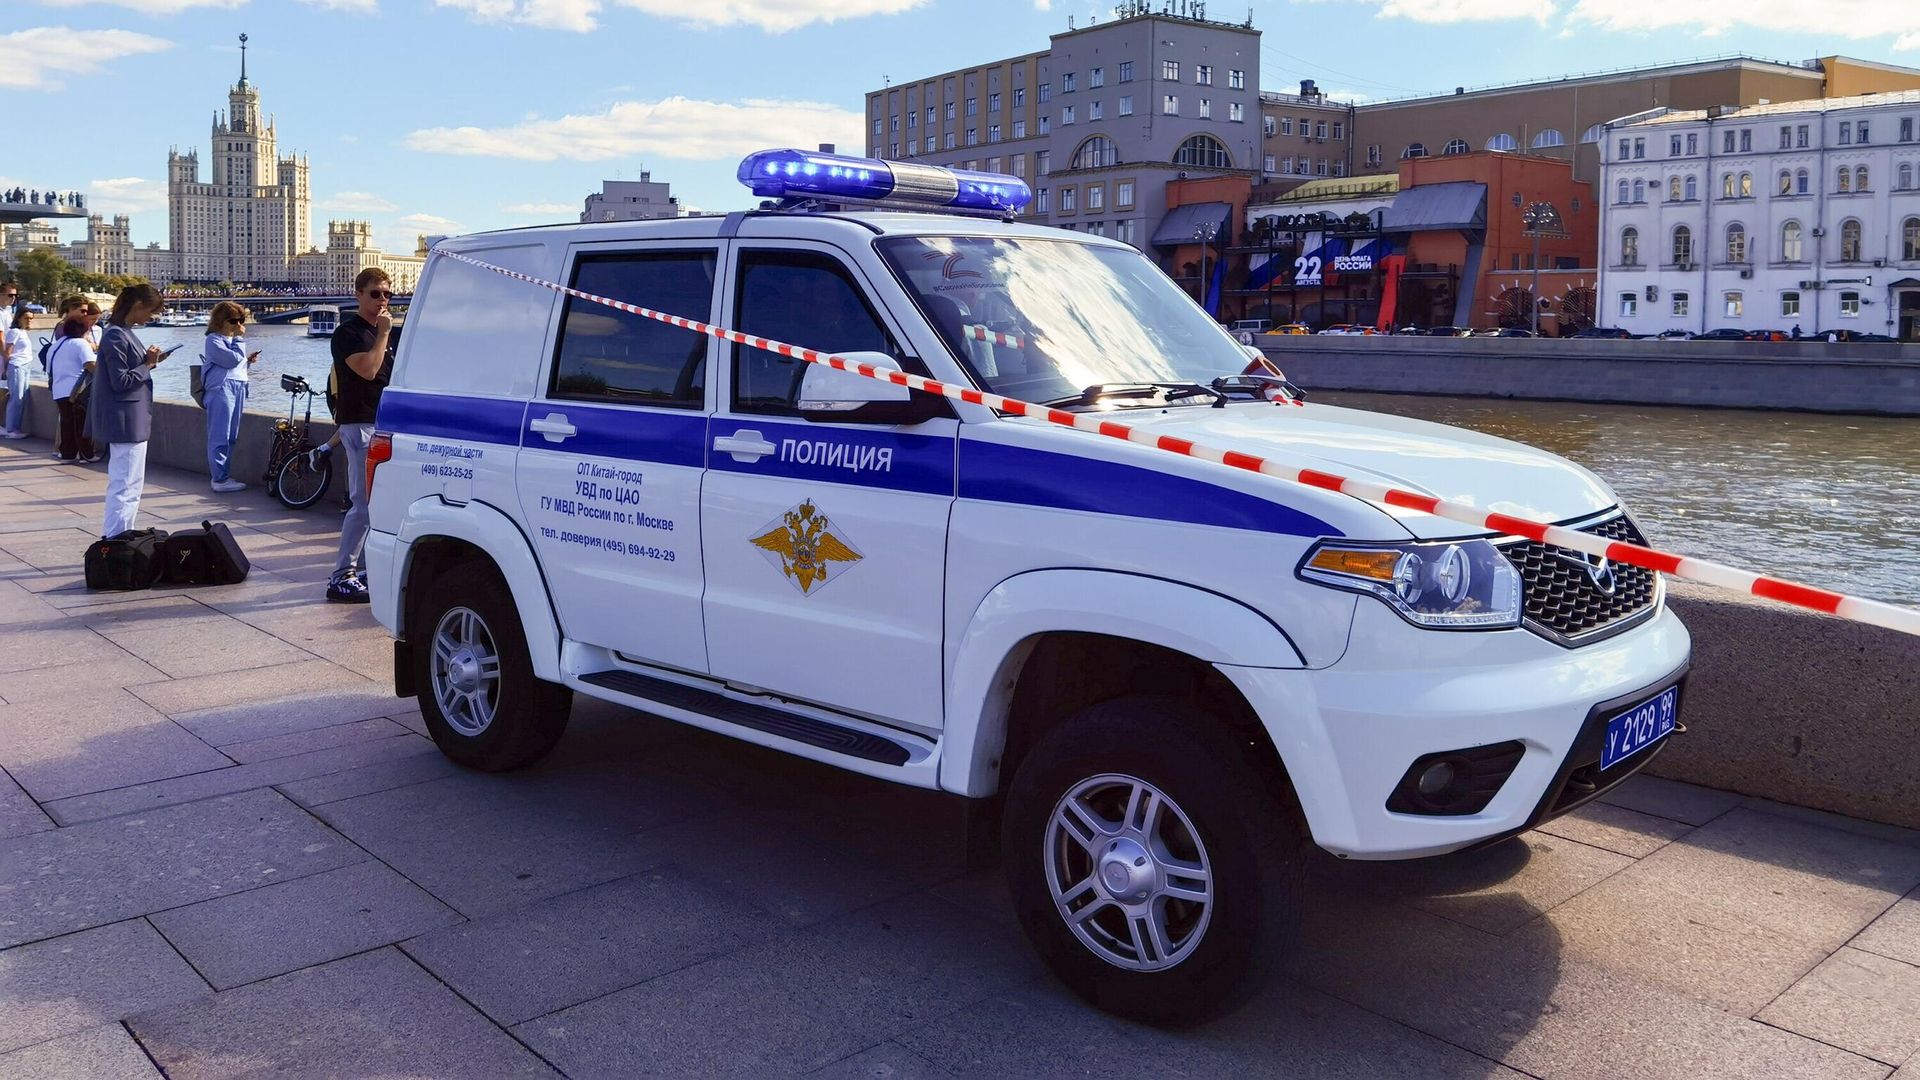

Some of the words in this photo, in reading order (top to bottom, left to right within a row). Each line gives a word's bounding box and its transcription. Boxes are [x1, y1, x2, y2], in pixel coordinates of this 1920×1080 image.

[1294, 256, 1322, 280] 22
[1334, 261, 1372, 271] РОССИИ
[416, 442, 429, 452] тел.
[429, 444, 463, 457] дежурной
[463, 448, 484, 459] части
[780, 438, 893, 473] ПОЛИЦИЯ
[421, 463, 438, 478] (499)
[439, 466, 474, 480] 623-25-25
[577, 462, 590, 475] ОП
[590, 463, 643, 485] Китай-город
[575, 480, 597, 500] УВД
[599, 487, 613, 500] по
[615, 486, 640, 506] ЦАО
[540, 496, 552, 510] ГУ
[554, 498, 575, 517] МВД
[577, 502, 611, 521] России
[613, 511, 626, 523] по
[627, 513, 634, 525] г.
[636, 511, 674, 531] Москве
[540, 527, 559, 540] тел.
[560, 530, 602, 548] доверия
[603, 538, 626, 555] (495)
[628, 543, 676, 562] 694-92-29
[1622, 704, 1656, 753] 2129
[1662, 692, 1673, 720] 99
[1662, 719, 1670, 731] RUS
